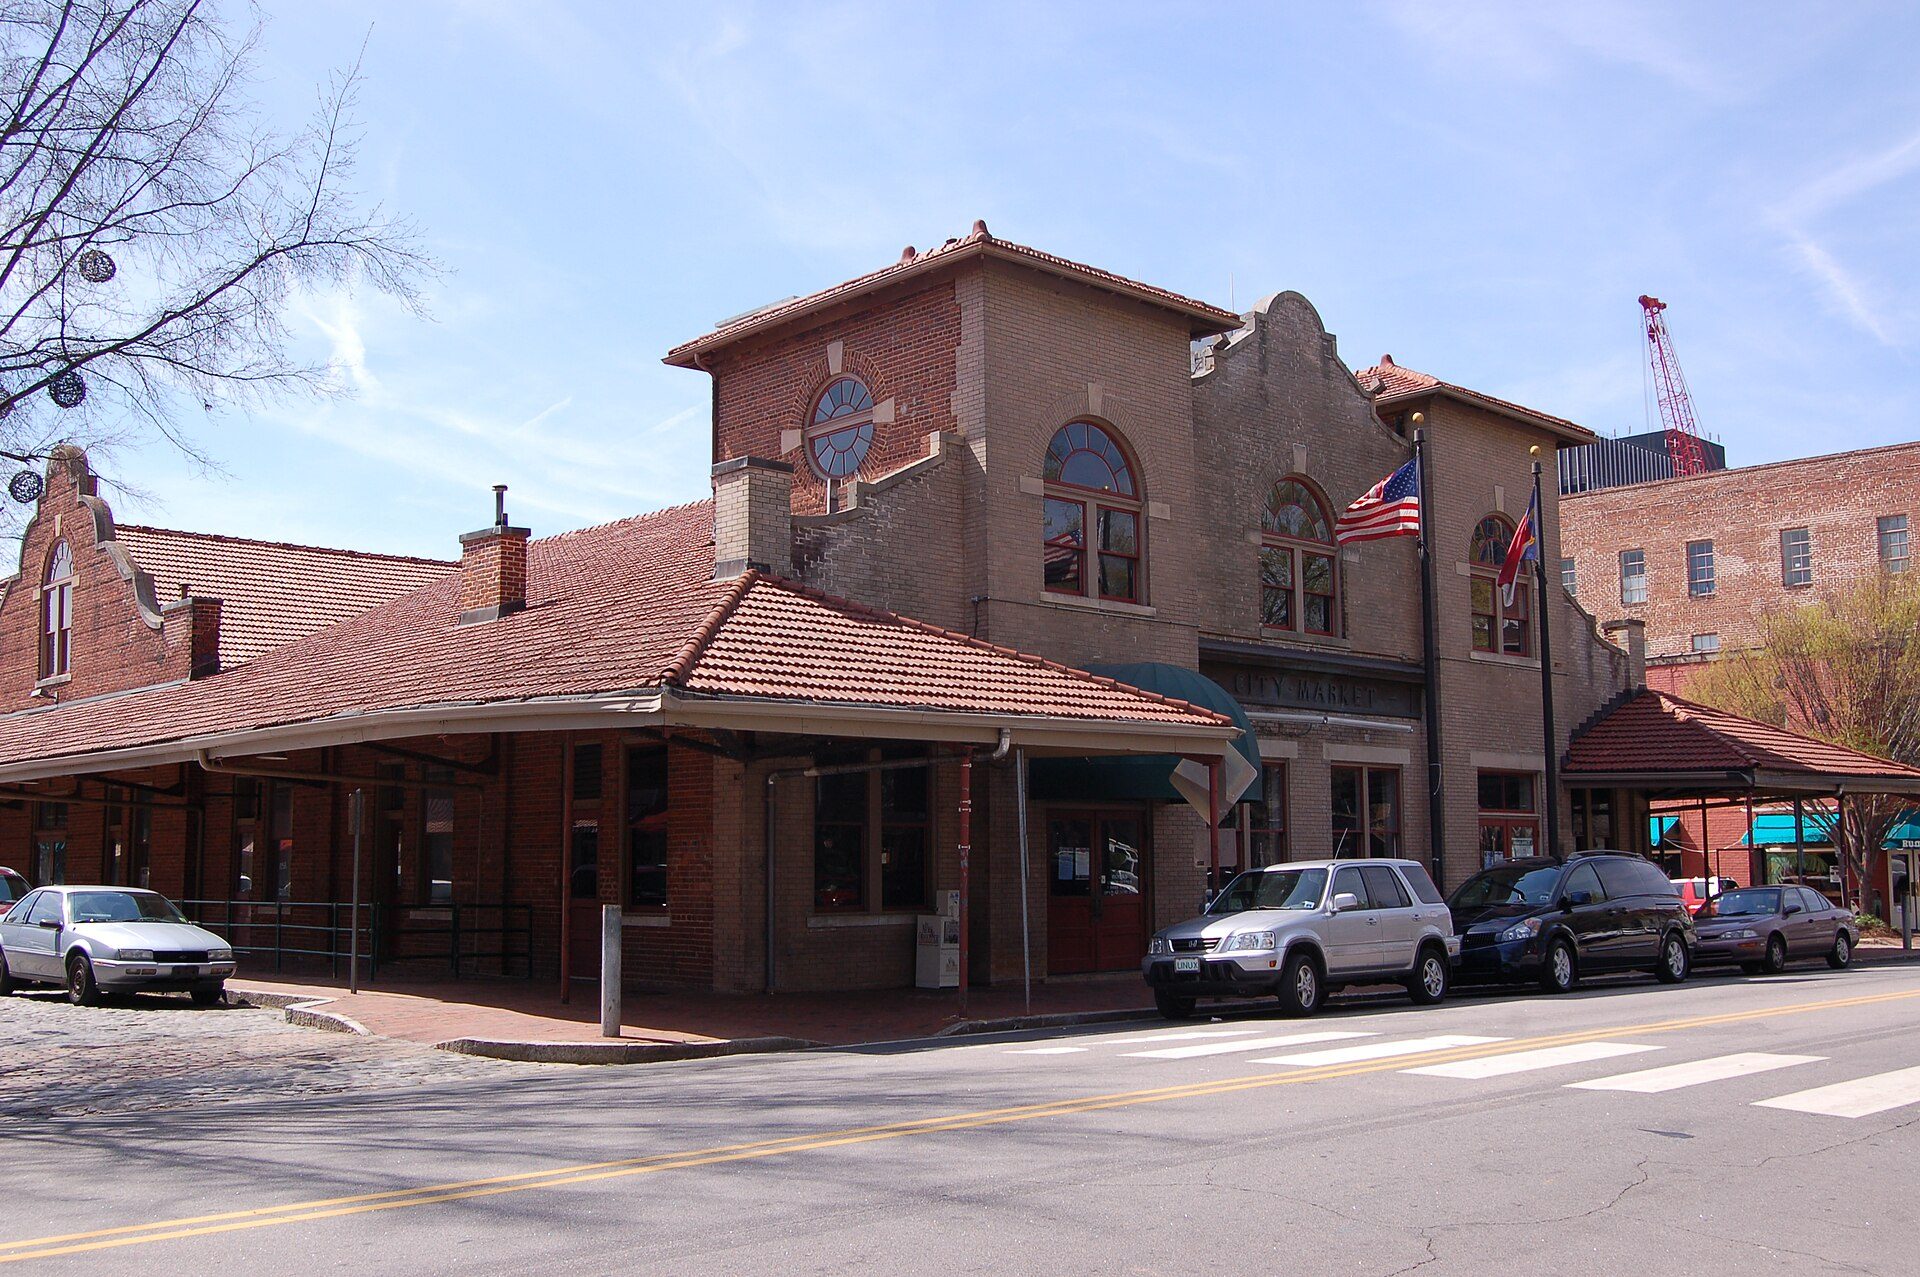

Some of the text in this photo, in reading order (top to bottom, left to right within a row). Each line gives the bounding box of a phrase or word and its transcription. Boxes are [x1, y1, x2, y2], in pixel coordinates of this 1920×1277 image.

[1234, 672, 1377, 709] CITY MARKET
[1176, 961, 1198, 970] LINUX
